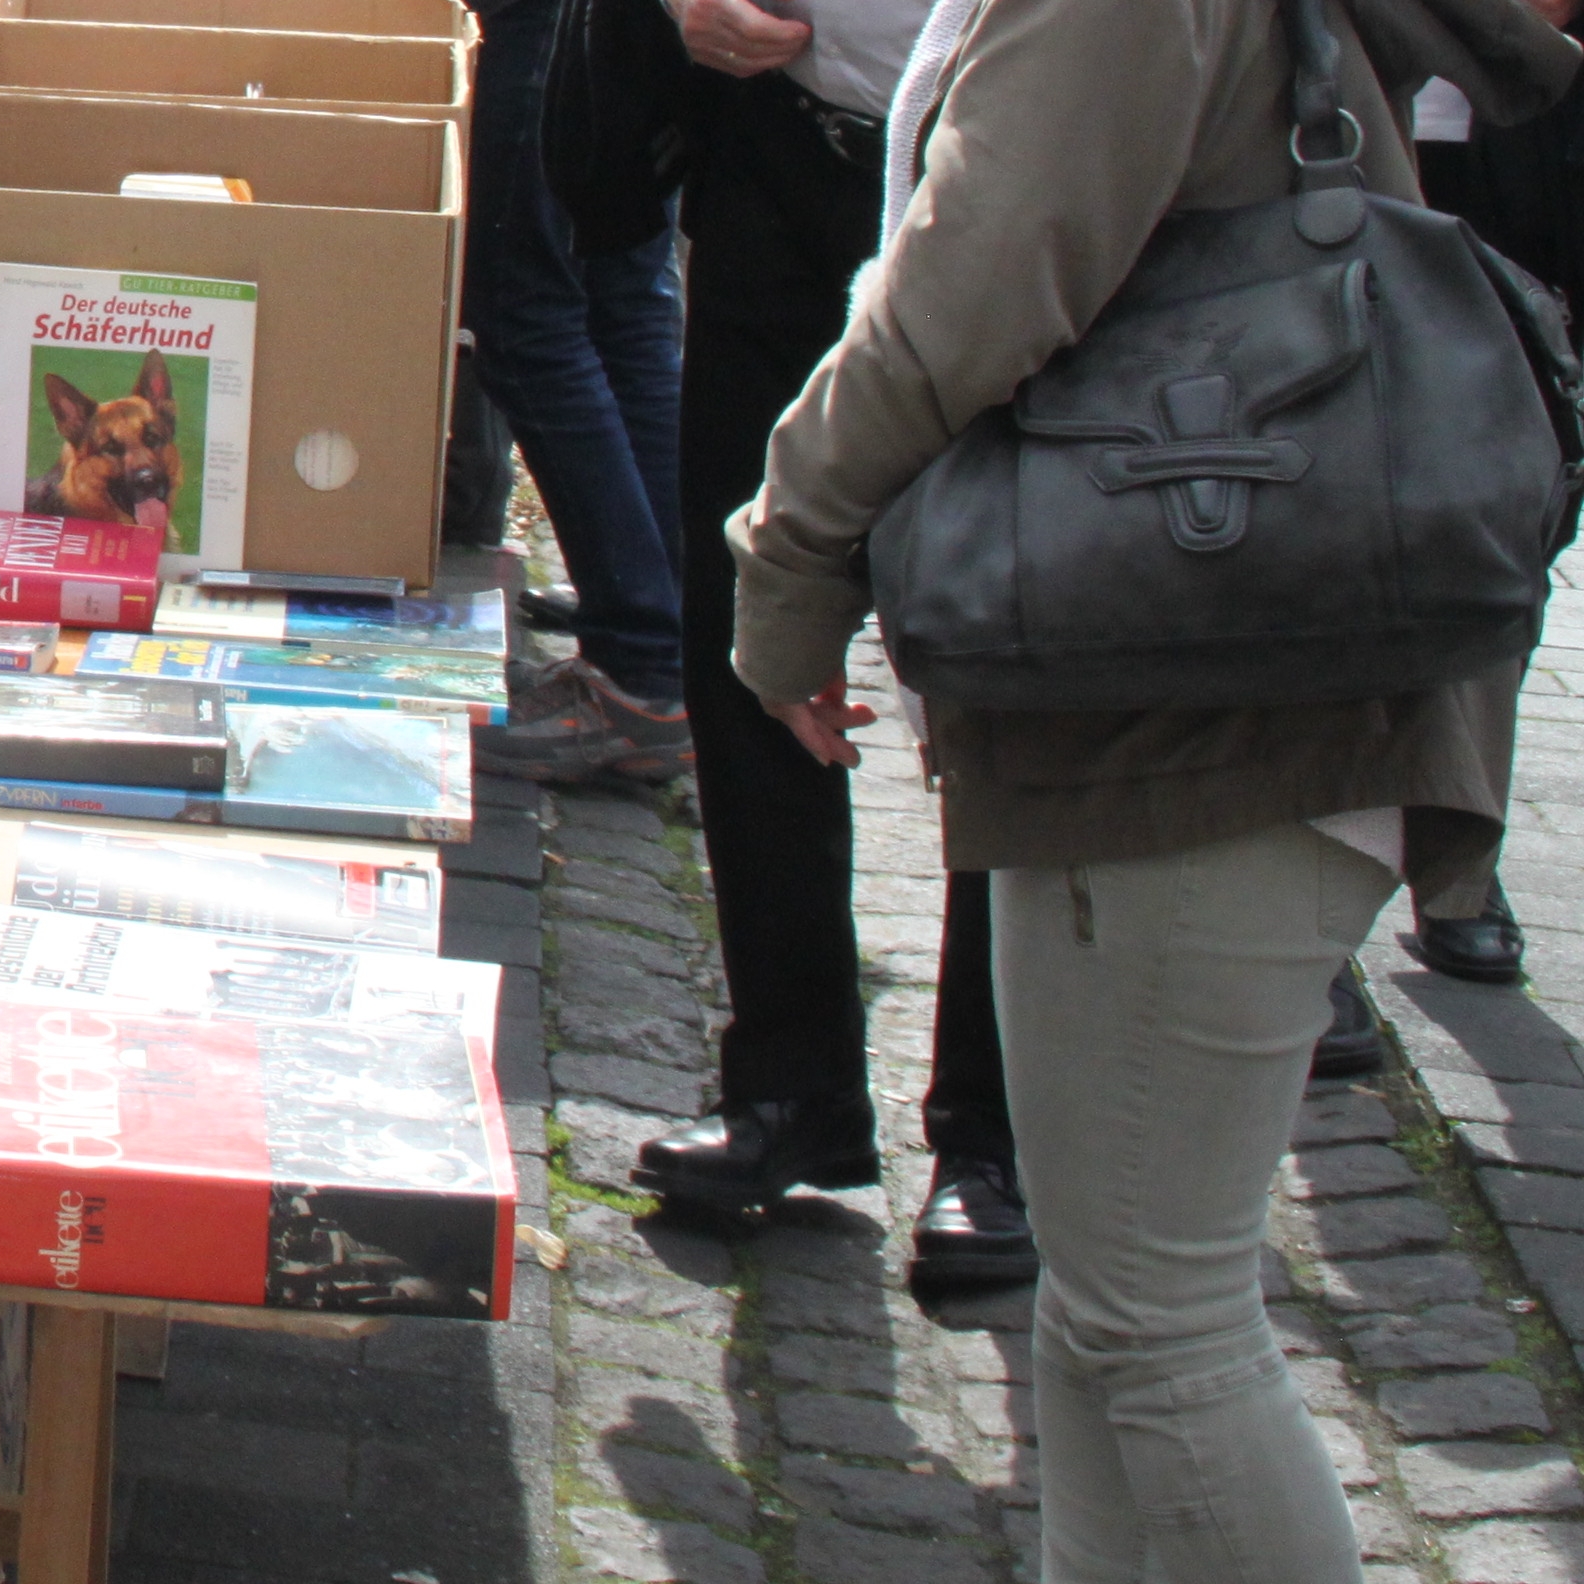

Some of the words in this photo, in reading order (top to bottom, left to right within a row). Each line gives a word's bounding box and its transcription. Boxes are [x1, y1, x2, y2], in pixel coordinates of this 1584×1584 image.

[60, 293, 98, 312] Der
[103, 295, 193, 319] deutsche
[123, 277, 141, 290] GU
[146, 278, 243, 298] TIER-RATGEBER
[32, 313, 215, 351] Schäferhund
[3, 514, 65, 568] PENDEL
[37, 952, 64, 990] der
[64, 921, 125, 997] Architektur
[37, 1189, 85, 1291] etikette
